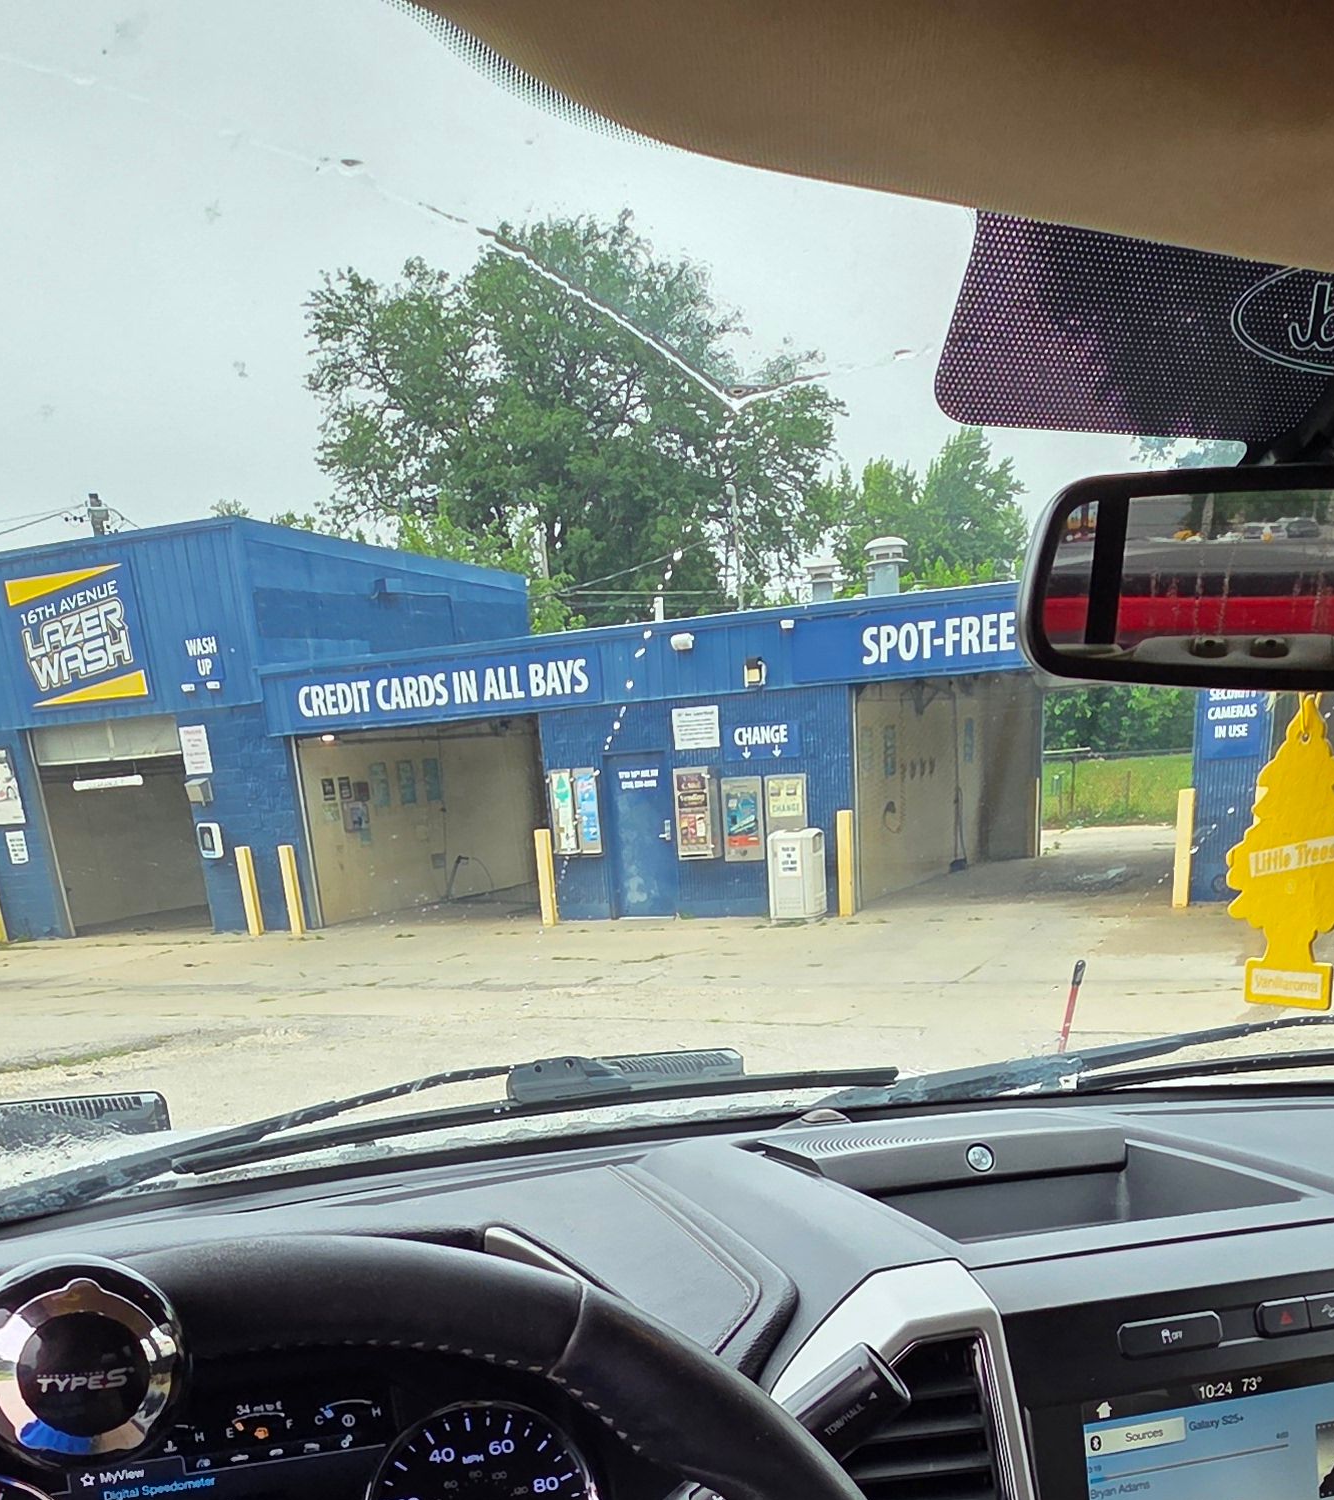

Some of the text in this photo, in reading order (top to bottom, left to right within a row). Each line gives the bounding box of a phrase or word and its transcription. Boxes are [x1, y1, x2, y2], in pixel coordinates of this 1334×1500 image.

[20, 580, 119, 626] 16TH AVENUE
[22, 598, 128, 659] LAZER
[185, 636, 217, 657] WASH
[862, 612, 1016, 665] SPOT-FREE
[28, 630, 134, 691] WASH
[197, 658, 213, 677] UP
[298, 658, 590, 719] CREDIT CARDS IN ALL BAYS
[1207, 704, 1257, 720] CAMERAS
[733, 724, 789, 746] CHANGE
[1214, 724, 1248, 738] IN USE
[772, 803, 800, 813] CHANGE
[1255, 850, 1292, 874] Little
[1254, 974, 1318, 994] Vanillaroma
[1198, 1376, 1262, 1399] 10:24 73°
[314, 1415, 324, 1425] C
[372, 1407, 381, 1417] H
[225, 1427, 234, 1439] E
[286, 1418, 293, 1429] F
[1125, 1414, 1244, 1443] Sources Galaxy S25+
[195, 1432, 204, 1442] H
[428, 1448, 485, 1464] 40 MPH
[488, 1439, 515, 1455] 60
[99, 1468, 144, 1486] MyView
[533, 1477, 559, 1493] 80
[142, 1476, 216, 1498] Speedometer
[1090, 1480, 1151, 1500] Bryan Adams
